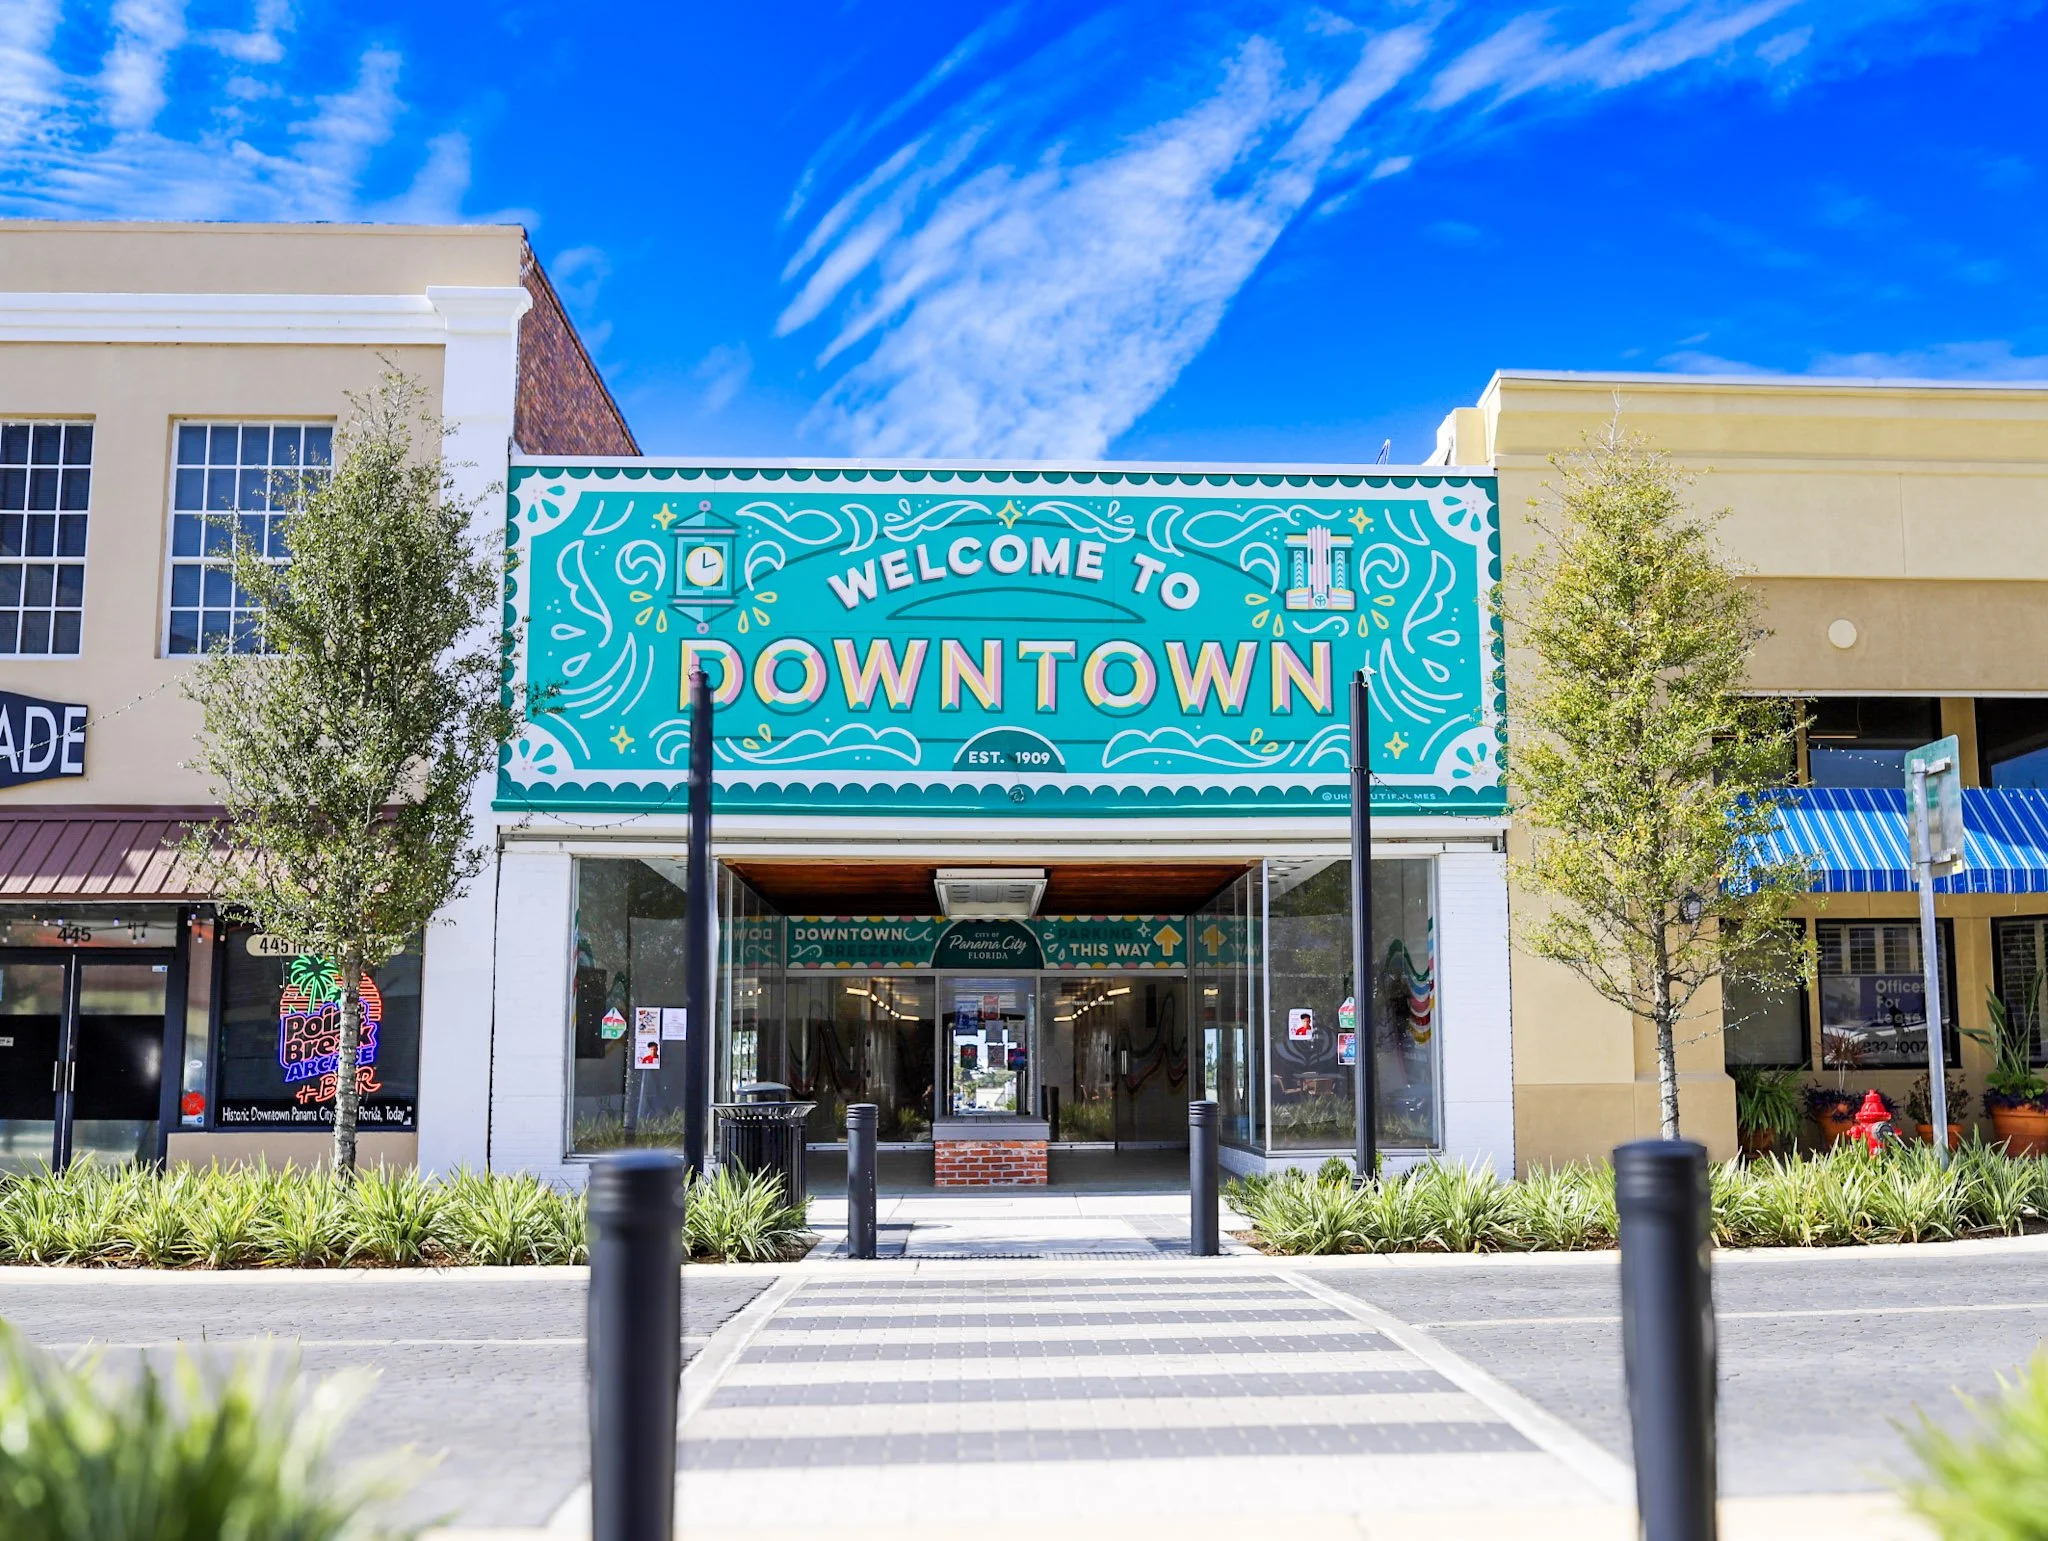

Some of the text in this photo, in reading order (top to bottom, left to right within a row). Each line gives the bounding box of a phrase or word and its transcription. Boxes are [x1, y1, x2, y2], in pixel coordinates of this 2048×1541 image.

[827, 534, 1200, 610] WELCOME TO
[679, 637, 1333, 716] DOWNTOWN
[968, 751, 1050, 765] EST. 1909
[57, 927, 91, 942] 445
[795, 928, 903, 941] DOWNTOWN
[1058, 928, 1133, 940] PARKING
[259, 937, 289, 954] 445
[823, 944, 928, 957] BREEZEWAY
[949, 934, 1028, 954] Panama City
[1069, 943, 1151, 956] THIS WAY
[968, 951, 1009, 960] FLORIDA
[1876, 996, 1900, 1009] For
[1877, 1012, 1921, 1024] Lease
[222, 1106, 249, 1121] Historic
[251, 1106, 290, 1121] Downtown
[291, 1106, 317, 1121] Panama
